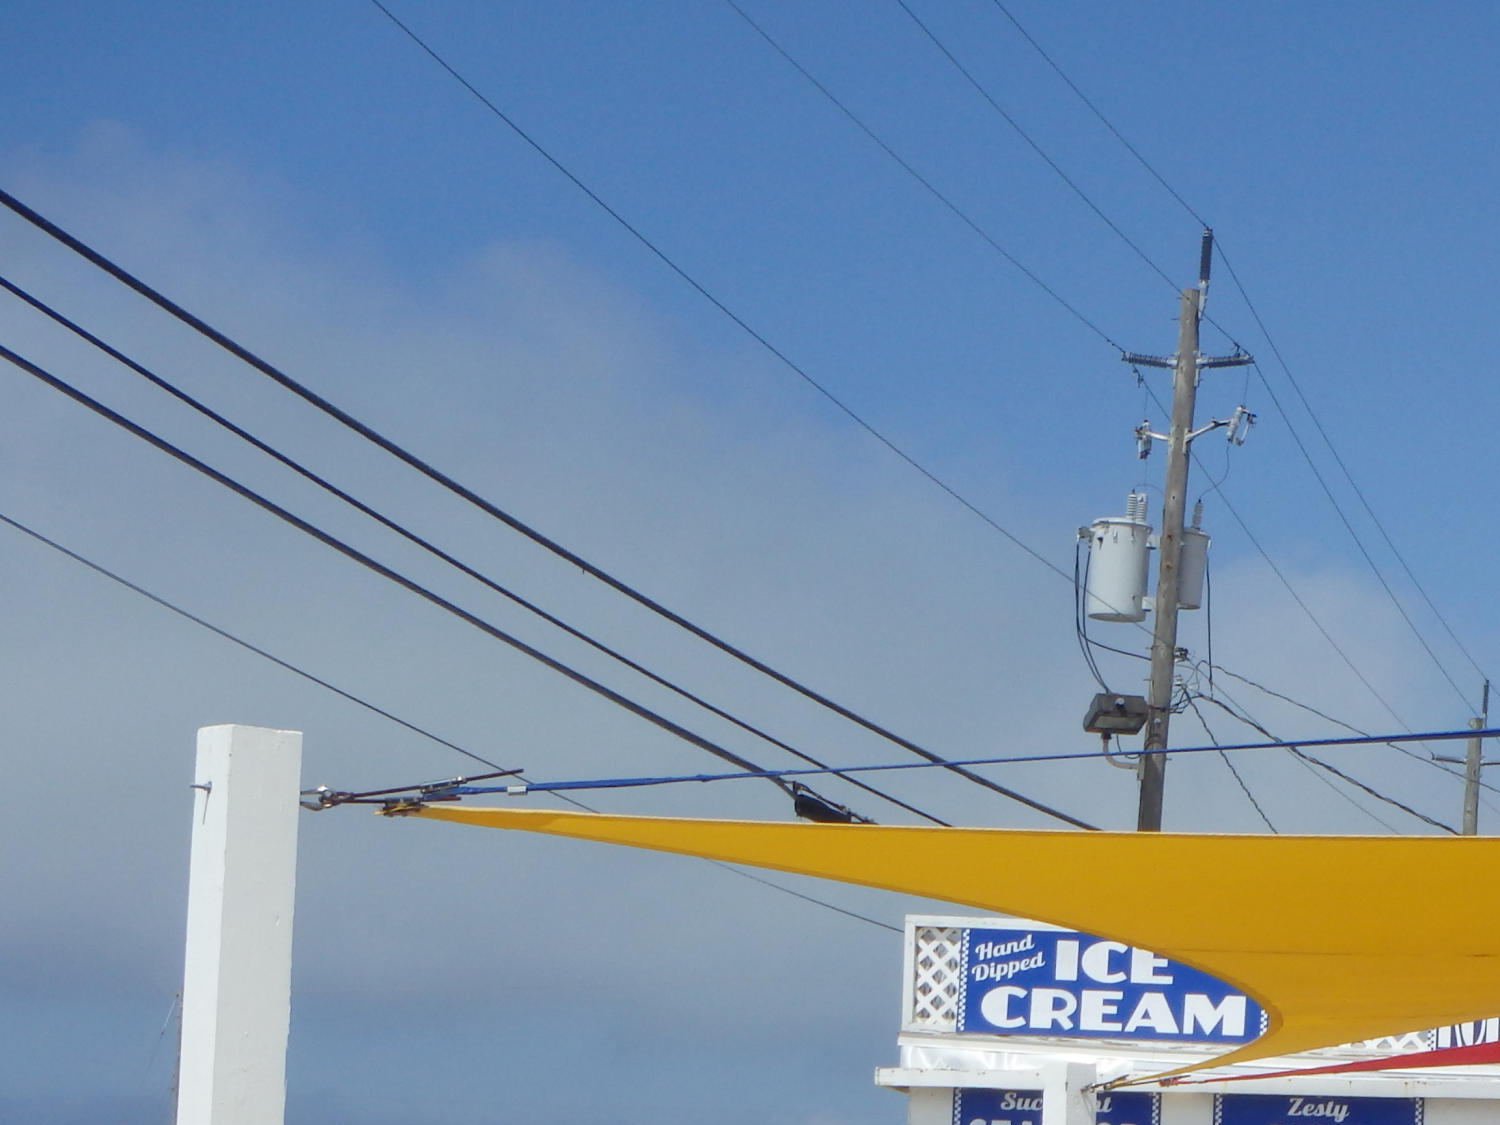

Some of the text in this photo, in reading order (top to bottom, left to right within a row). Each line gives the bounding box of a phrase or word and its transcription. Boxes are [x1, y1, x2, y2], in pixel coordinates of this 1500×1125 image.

[974, 934, 1035, 961] Hand
[1055, 940, 1173, 984] ICE
[971, 951, 1046, 982] Dipped
[980, 985, 1247, 1037] CREAM
[1287, 1097, 1350, 1122] Zesty
